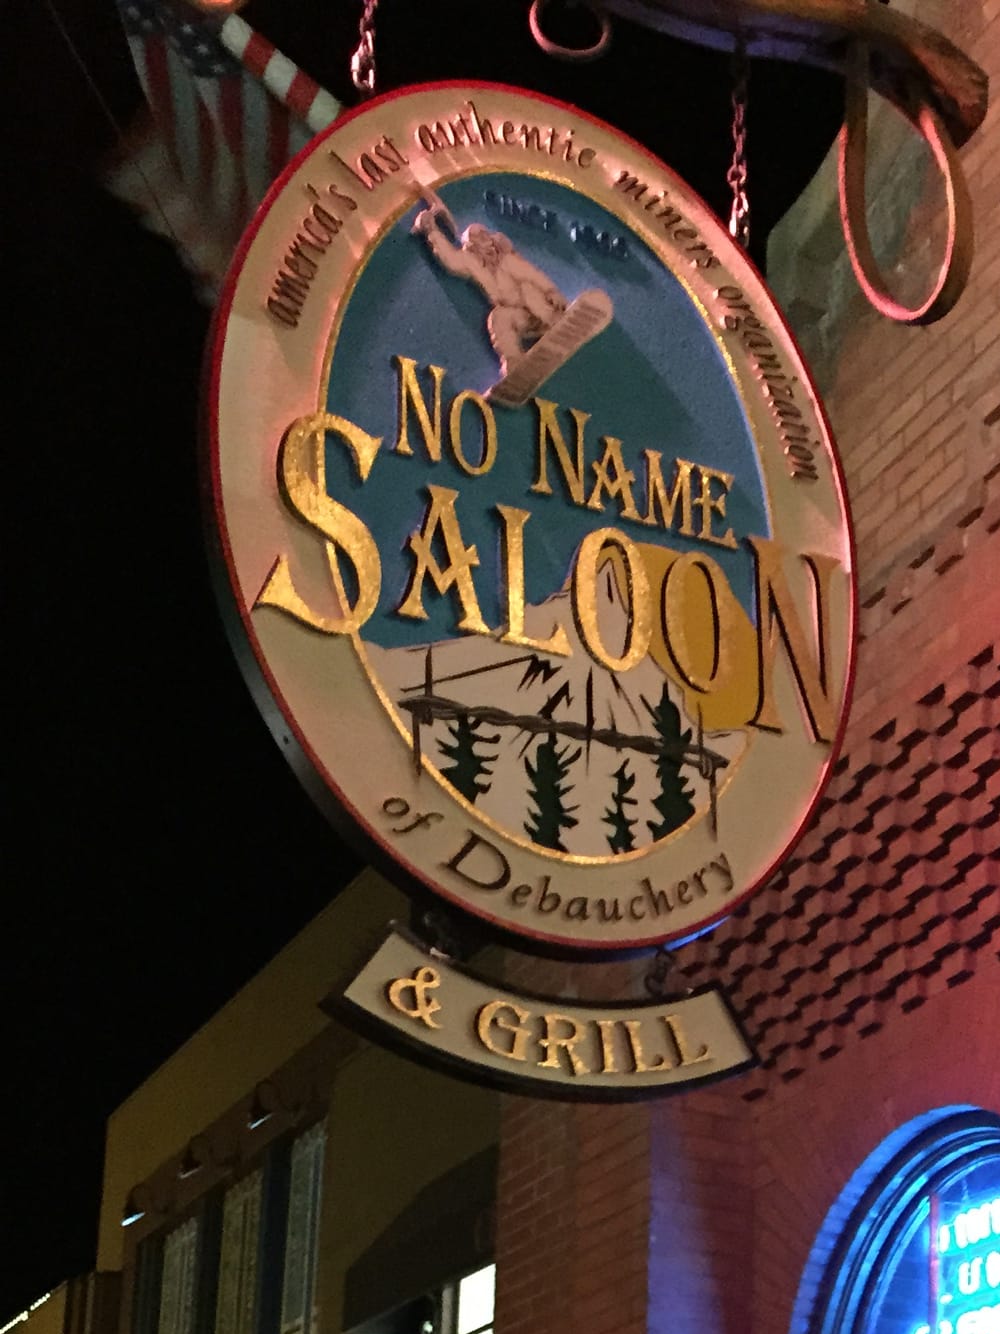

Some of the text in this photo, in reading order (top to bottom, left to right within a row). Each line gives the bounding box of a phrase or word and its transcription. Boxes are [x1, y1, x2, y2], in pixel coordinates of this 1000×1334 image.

[329, 134, 409, 191] last
[414, 100, 597, 169] authentic
[612, 170, 720, 269] miners
[713, 285, 821, 481] organization
[391, 354, 738, 549] NO NAME
[251, 411, 842, 744] SALOON
[381, 795, 735, 923] of Debauchery
[386, 965, 715, 1077] & GRILL
